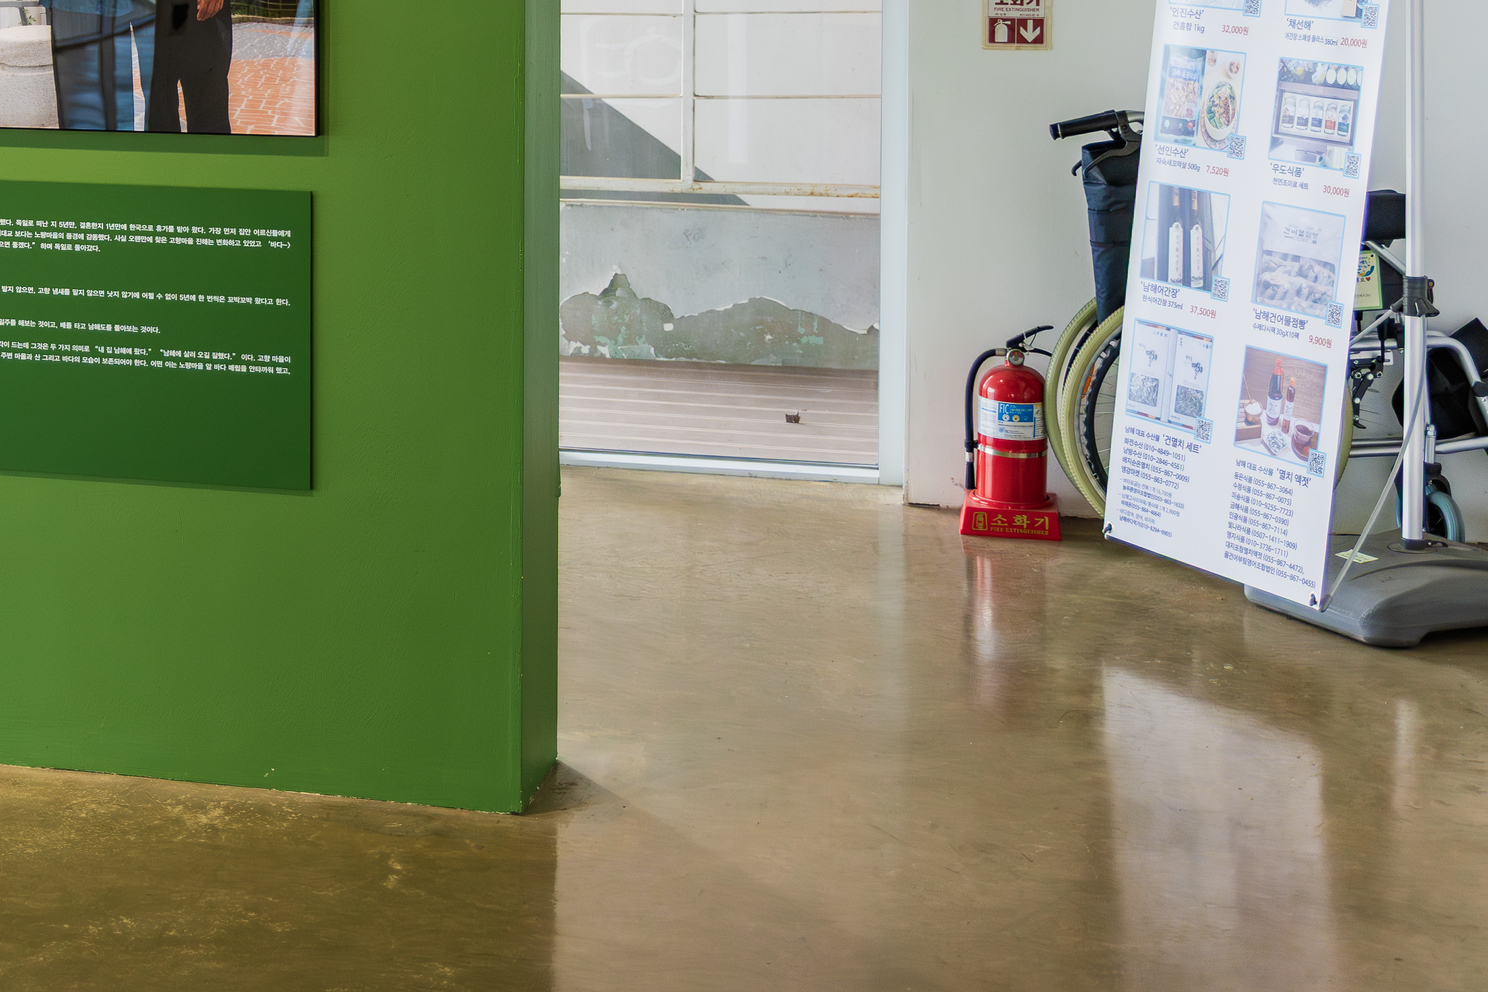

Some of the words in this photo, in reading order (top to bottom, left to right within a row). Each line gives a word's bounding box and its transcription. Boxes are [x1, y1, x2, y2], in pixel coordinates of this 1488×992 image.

[1194, 23, 1205, 34] 1kg
[1221, 24, 1249, 36] 32,000원
[1340, 37, 1367, 48] 20,000원
[1187, 163, 1201, 172] 500g
[1206, 165, 1229, 177] 7,520원
[1323, 184, 1350, 198] 30,000원
[191, 226, 206, 234] 왔다.
[253, 229, 291, 237] 어르신들에게
[1190, 305, 1217, 319] 37,500원
[1308, 334, 1332, 349] 9,900원
[1125, 426, 1135, 434] 남해
[1135, 428, 1145, 437] 대표
[1145, 431, 1160, 442] 수산물
[1235, 459, 1246, 468] 남해
[1247, 462, 1257, 471] 대표
[1258, 465, 1273, 476] 수산물
[991, 514, 1049, 530] 소화기
